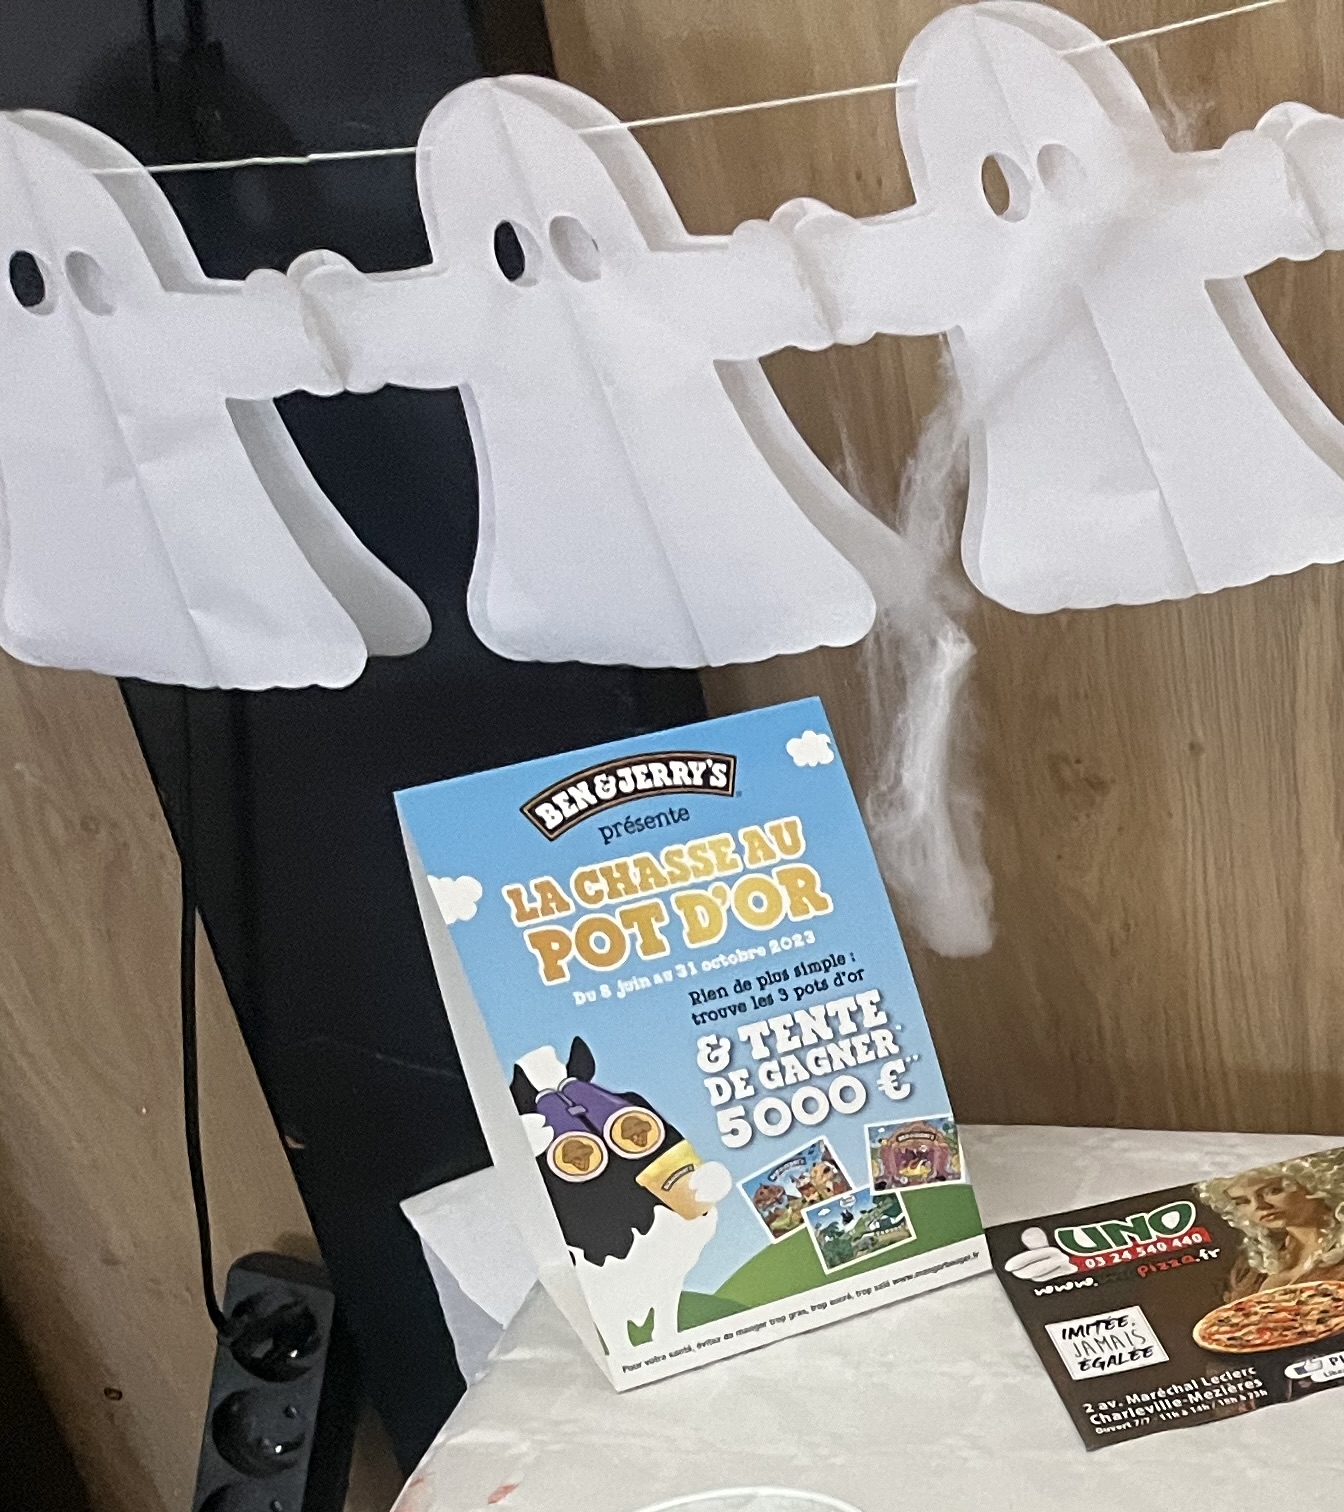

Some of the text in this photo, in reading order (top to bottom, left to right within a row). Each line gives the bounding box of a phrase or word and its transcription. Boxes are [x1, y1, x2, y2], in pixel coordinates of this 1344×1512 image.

[598, 805, 690, 845] présente
[502, 816, 805, 927] LA CHASSE AU
[524, 863, 834, 986] POT D'OR
[573, 930, 815, 1005] Du 8 juin au 31 octobre 2023
[689, 986, 728, 1006] Rien
[734, 979, 752, 993] de
[756, 968, 790, 991] plus
[692, 969, 865, 1025] trouve les 3 pots d'or
[697, 989, 888, 1073] & TENTE
[704, 1068, 755, 1106] DE
[716, 1075, 867, 1148] 5000
[1054, 1201, 1196, 1256] UNO
[1085, 1233, 1203, 1268] 03 24 540 440
[1072, 1329, 1147, 1358] JAMAIS
[1082, 1367, 1257, 1414] 2 av. Maréchal Leclerc
[1095, 1421, 1132, 1434] Ouvert
